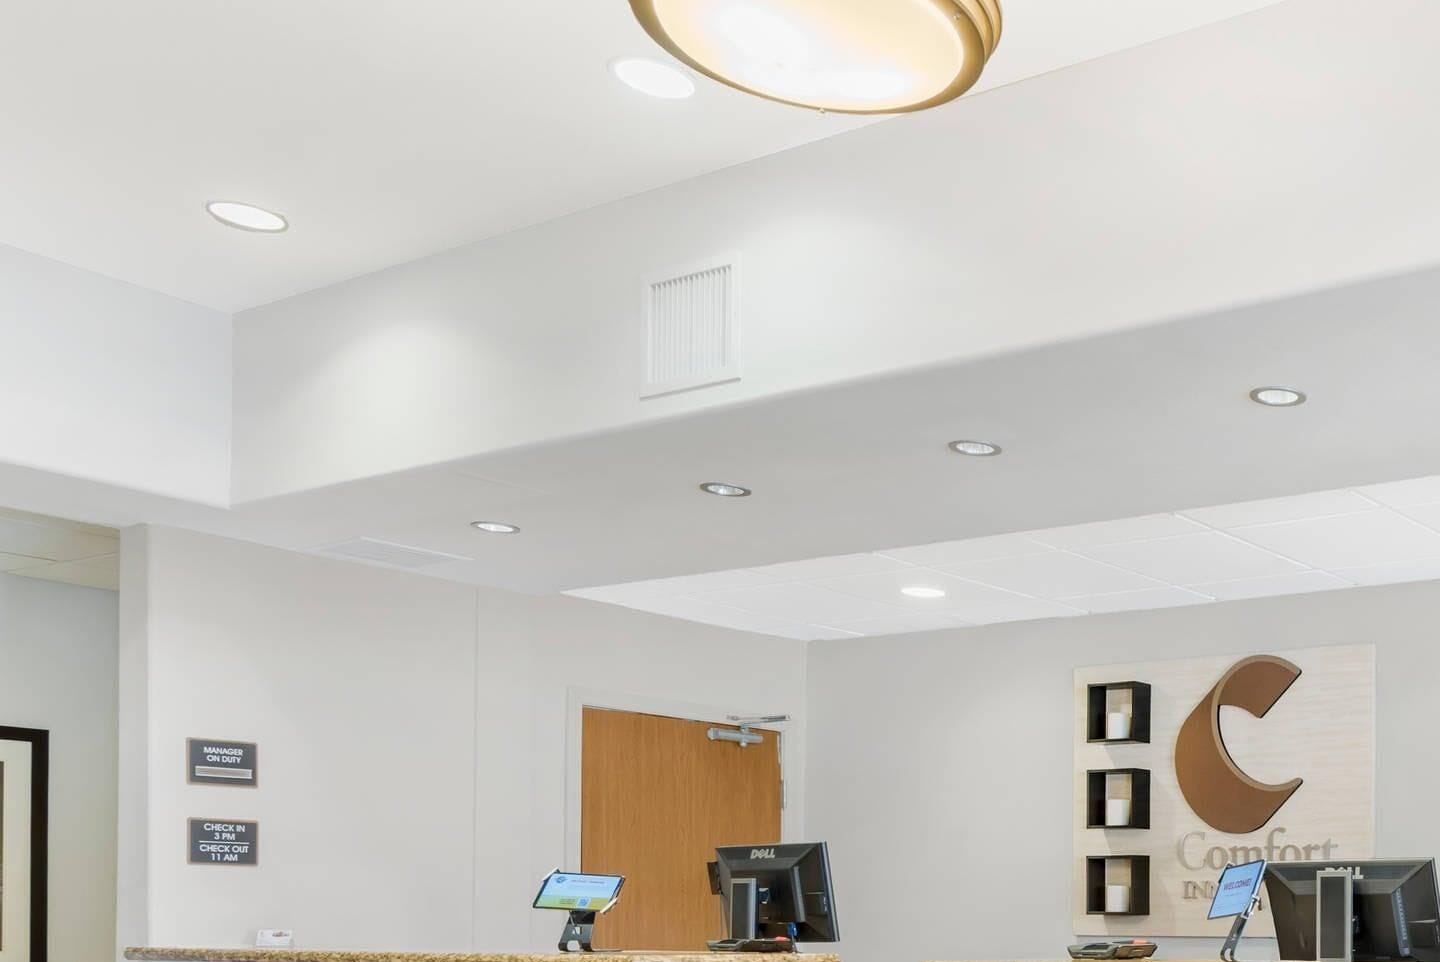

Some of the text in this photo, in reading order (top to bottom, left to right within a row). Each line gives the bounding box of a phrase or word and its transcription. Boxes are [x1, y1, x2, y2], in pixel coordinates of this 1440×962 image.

[203, 746, 243, 757] MANAGER
[206, 755, 242, 764] ON DUTY
[203, 823, 246, 833] CHECK IN
[214, 832, 236, 841] 3 PM
[199, 844, 249, 854] CHECK OUT
[750, 848, 776, 860] DELL
[1176, 827, 1339, 872] Comfort
[211, 853, 238, 862] 11 AM
[1182, 880, 1215, 900] IN
